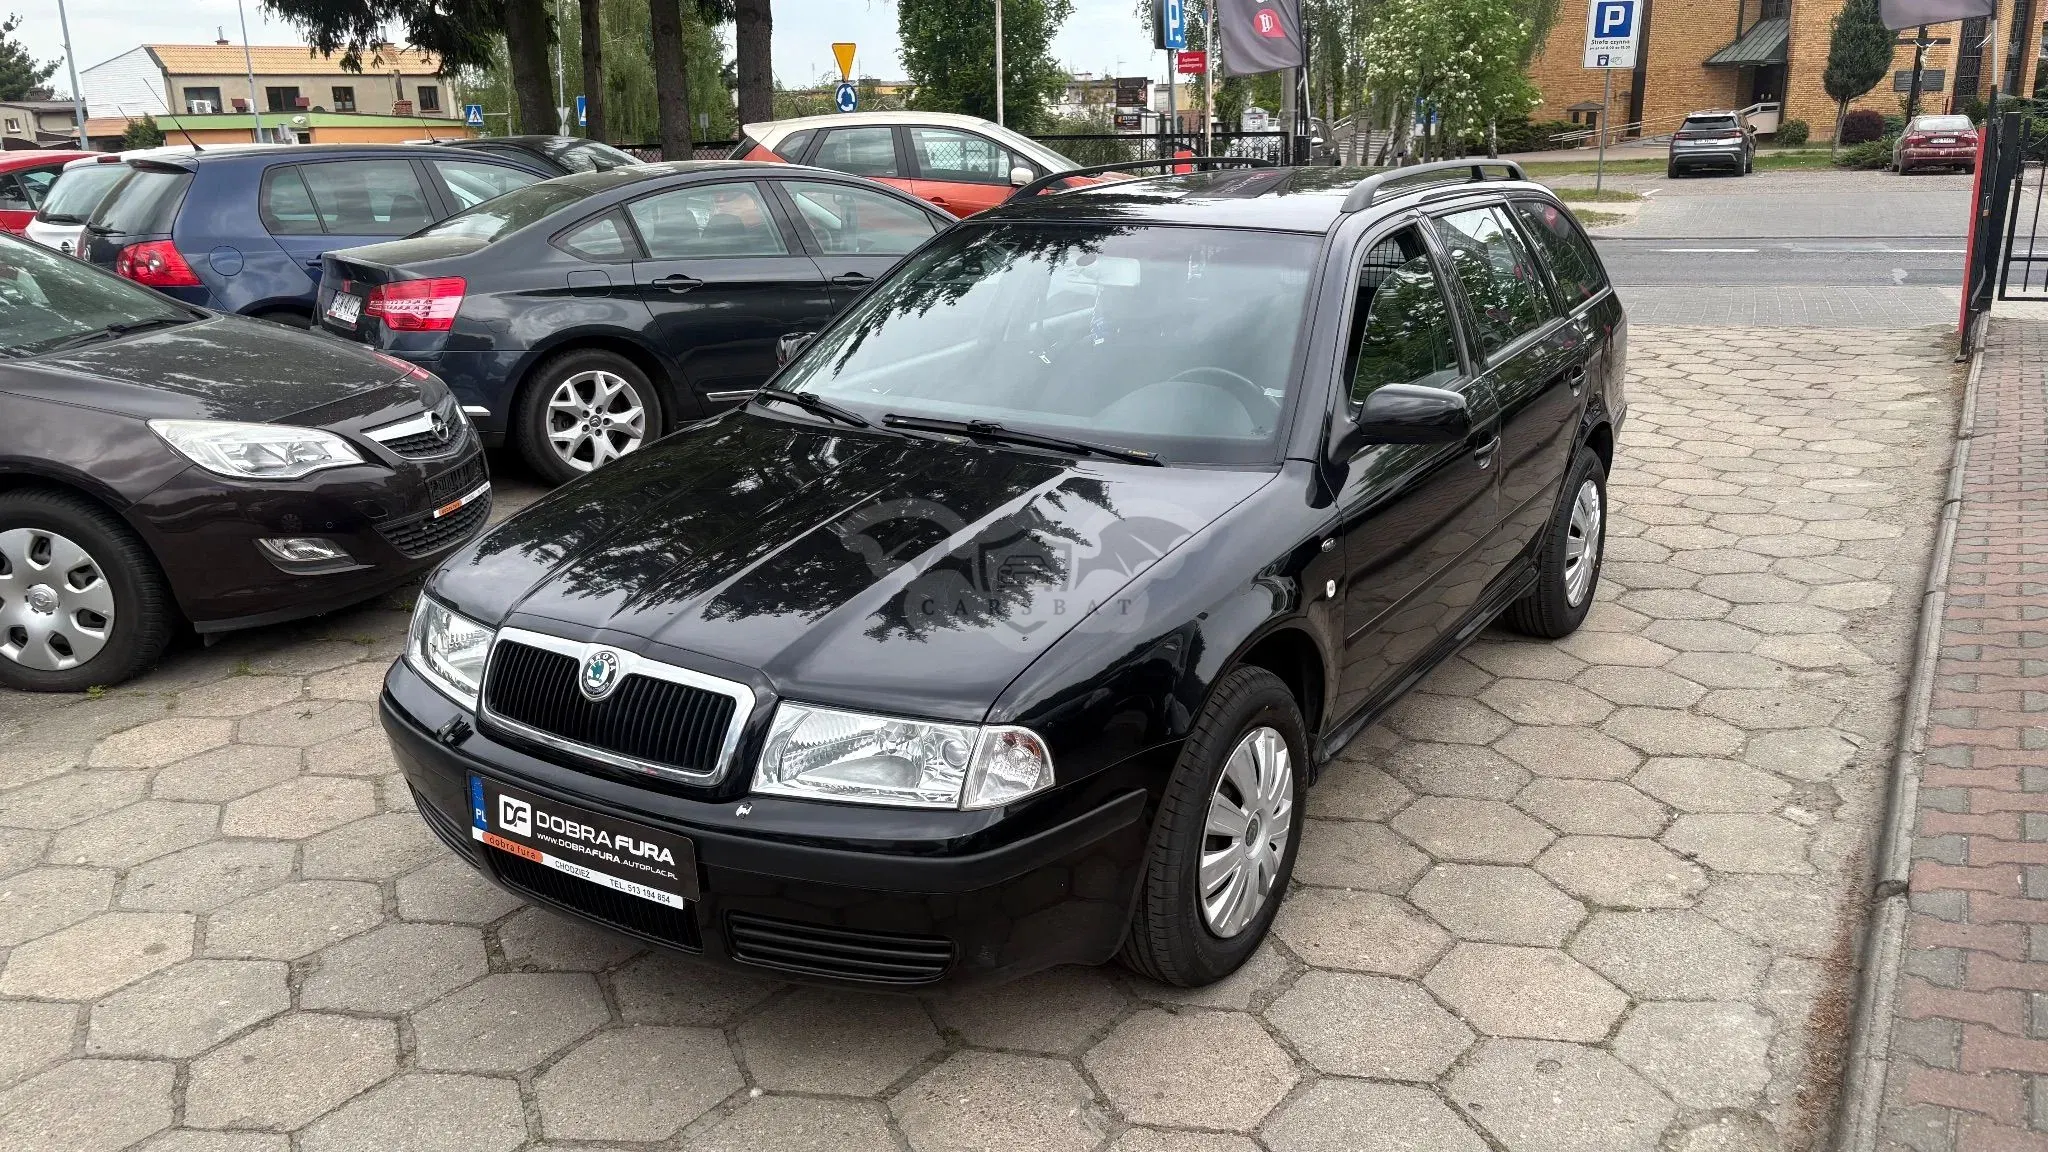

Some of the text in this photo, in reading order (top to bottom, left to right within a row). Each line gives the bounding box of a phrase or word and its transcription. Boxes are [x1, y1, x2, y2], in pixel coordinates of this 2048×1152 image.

[1169, 0, 1180, 40] P
[1603, 6, 1625, 33] P
[475, 807, 487, 823] PL
[489, 835, 536, 860] dobra fura
[536, 810, 676, 867] DOBRA FURA
[609, 878, 625, 891] TEL.
[627, 884, 641, 896] 513
[642, 888, 656, 899] 194
